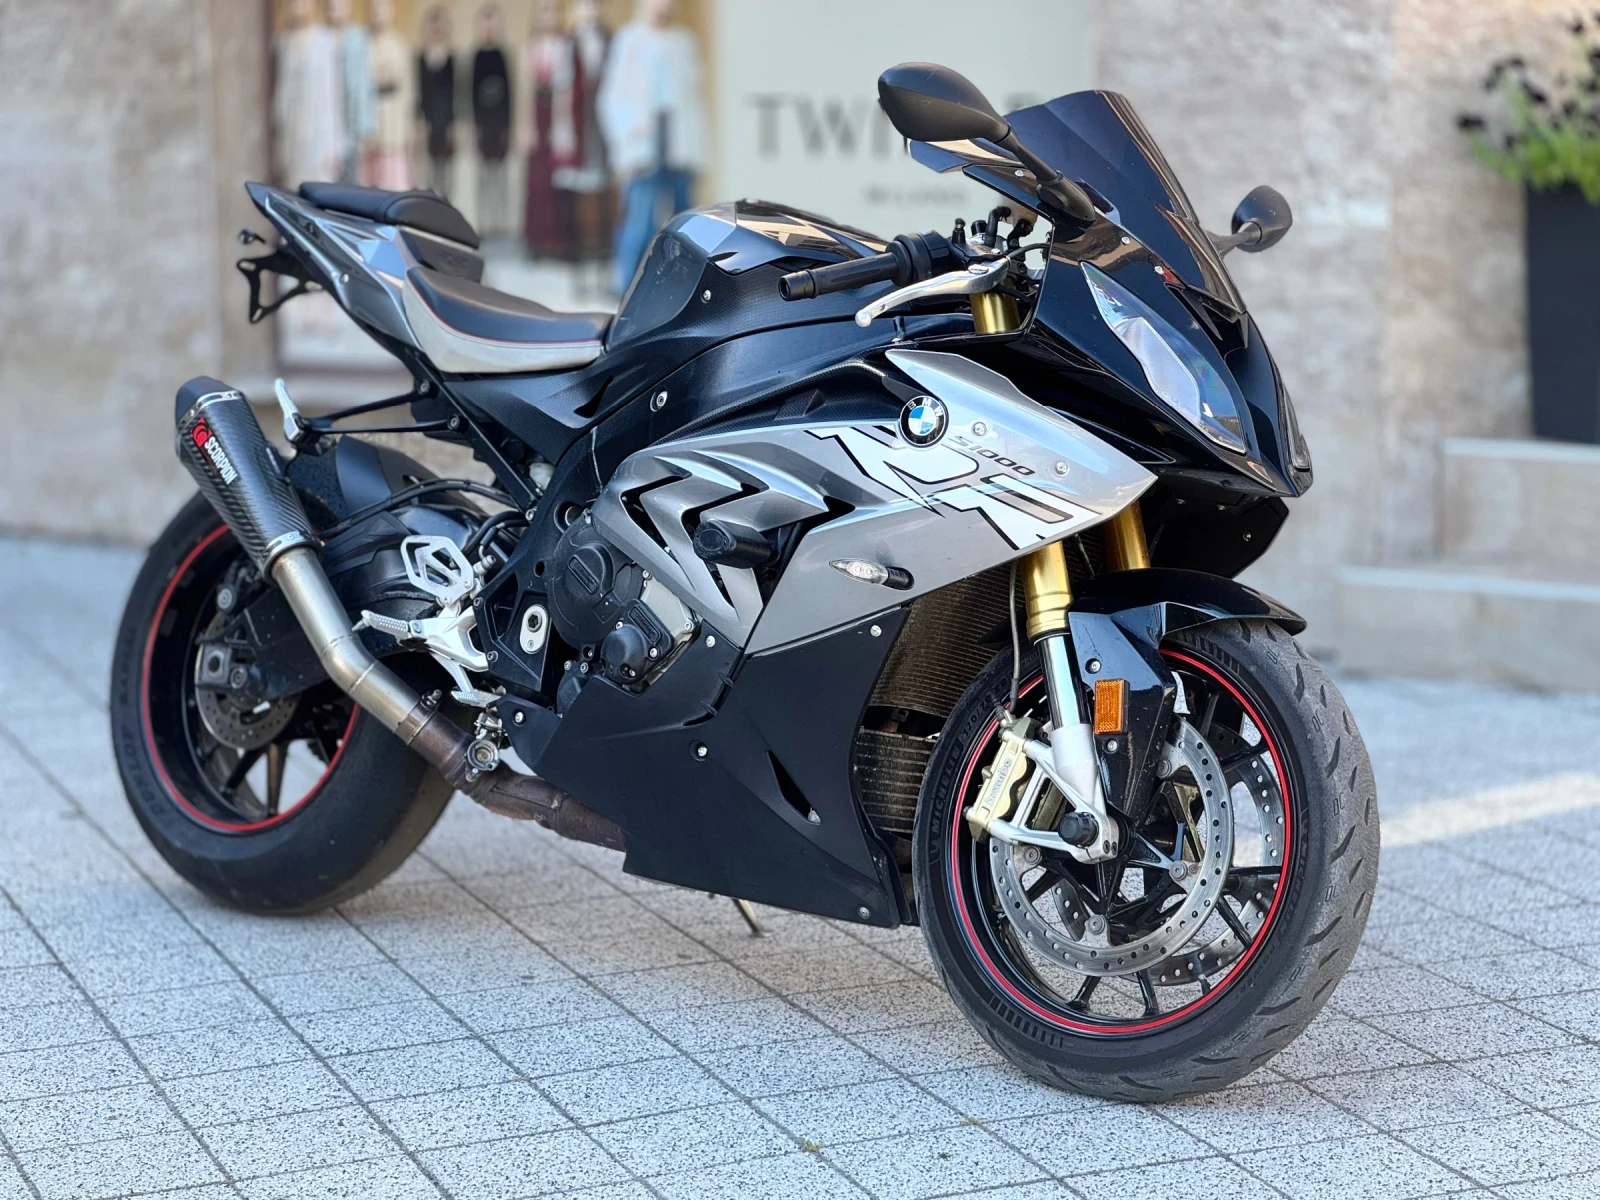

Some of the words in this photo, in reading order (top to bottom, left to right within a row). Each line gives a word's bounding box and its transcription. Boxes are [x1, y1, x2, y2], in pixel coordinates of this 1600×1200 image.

[907, 397, 945, 417] BMW
[203, 436, 238, 485] SCORPION
[948, 435, 1036, 476] S1000
[932, 742, 962, 835] MICHELIN
